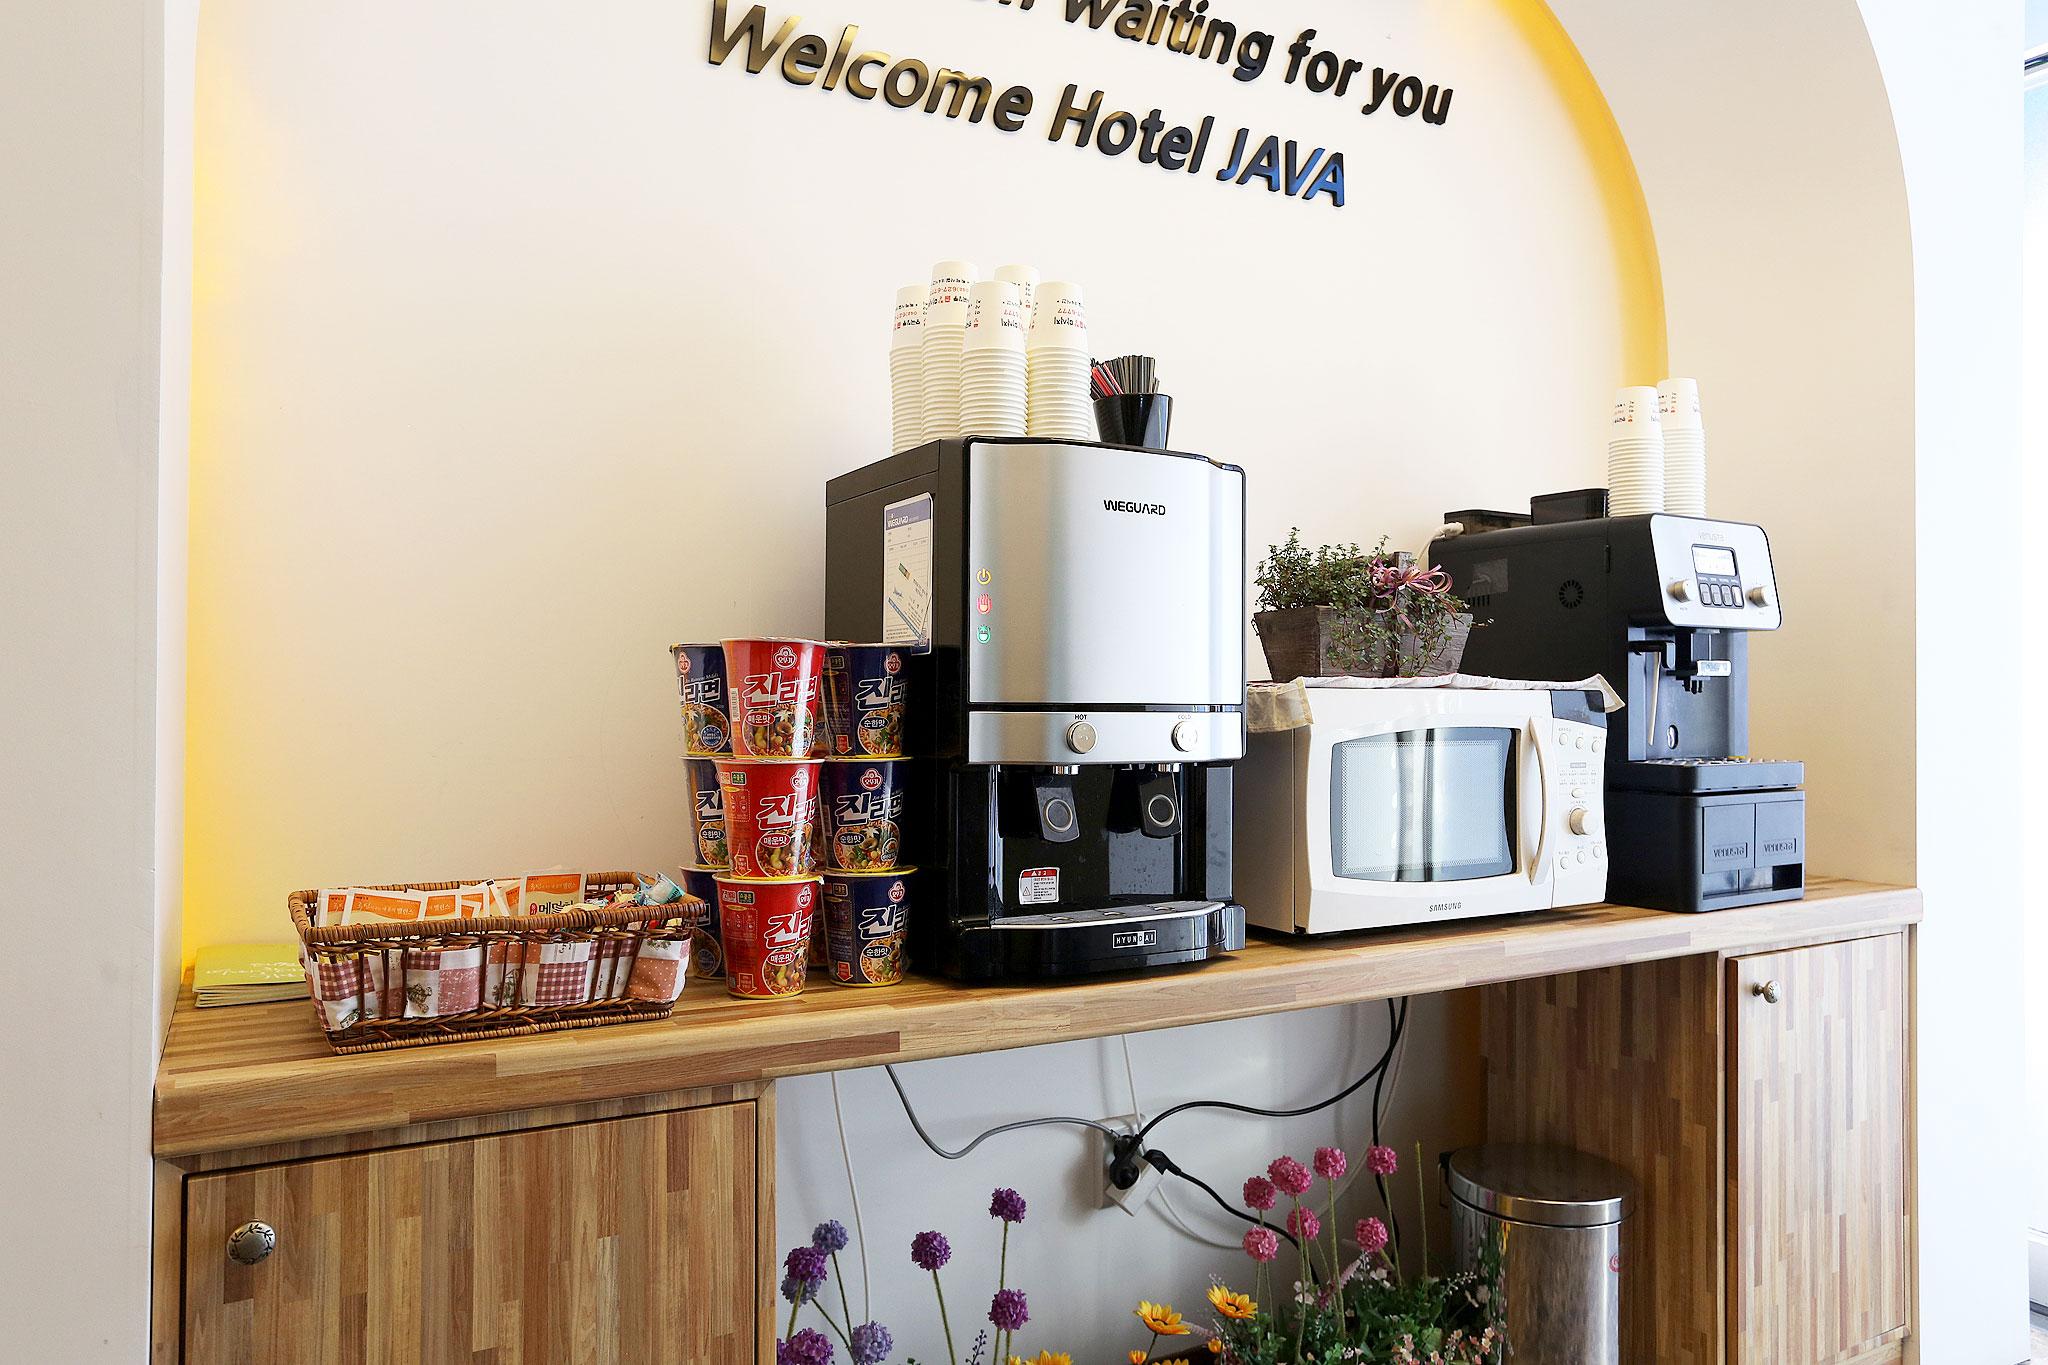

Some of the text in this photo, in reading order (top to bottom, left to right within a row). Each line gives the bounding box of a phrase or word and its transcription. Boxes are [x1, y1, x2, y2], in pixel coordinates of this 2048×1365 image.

[1065, 0, 1455, 126] waiting for you
[708, 0, 1346, 208] Welcome Hotel JAVA
[1103, 499, 1166, 516] WEGUARD
[678, 674, 720, 705] 라면
[742, 672, 818, 709] 진라면
[855, 676, 907, 711] 진라
[864, 719, 886, 727] 순한맛
[1074, 713, 1088, 721] HOT
[835, 791, 904, 826] 진라면
[763, 836, 787, 845] 매운맛
[840, 835, 862, 844] 순한맛
[1429, 901, 1462, 912] SAMSUNG
[764, 909, 813, 950] 진라
[858, 904, 909, 940] 진라
[1115, 932, 1155, 946] HYUNDAI
[771, 953, 792, 962] 매운맛
[866, 948, 888, 956] 순한맛
